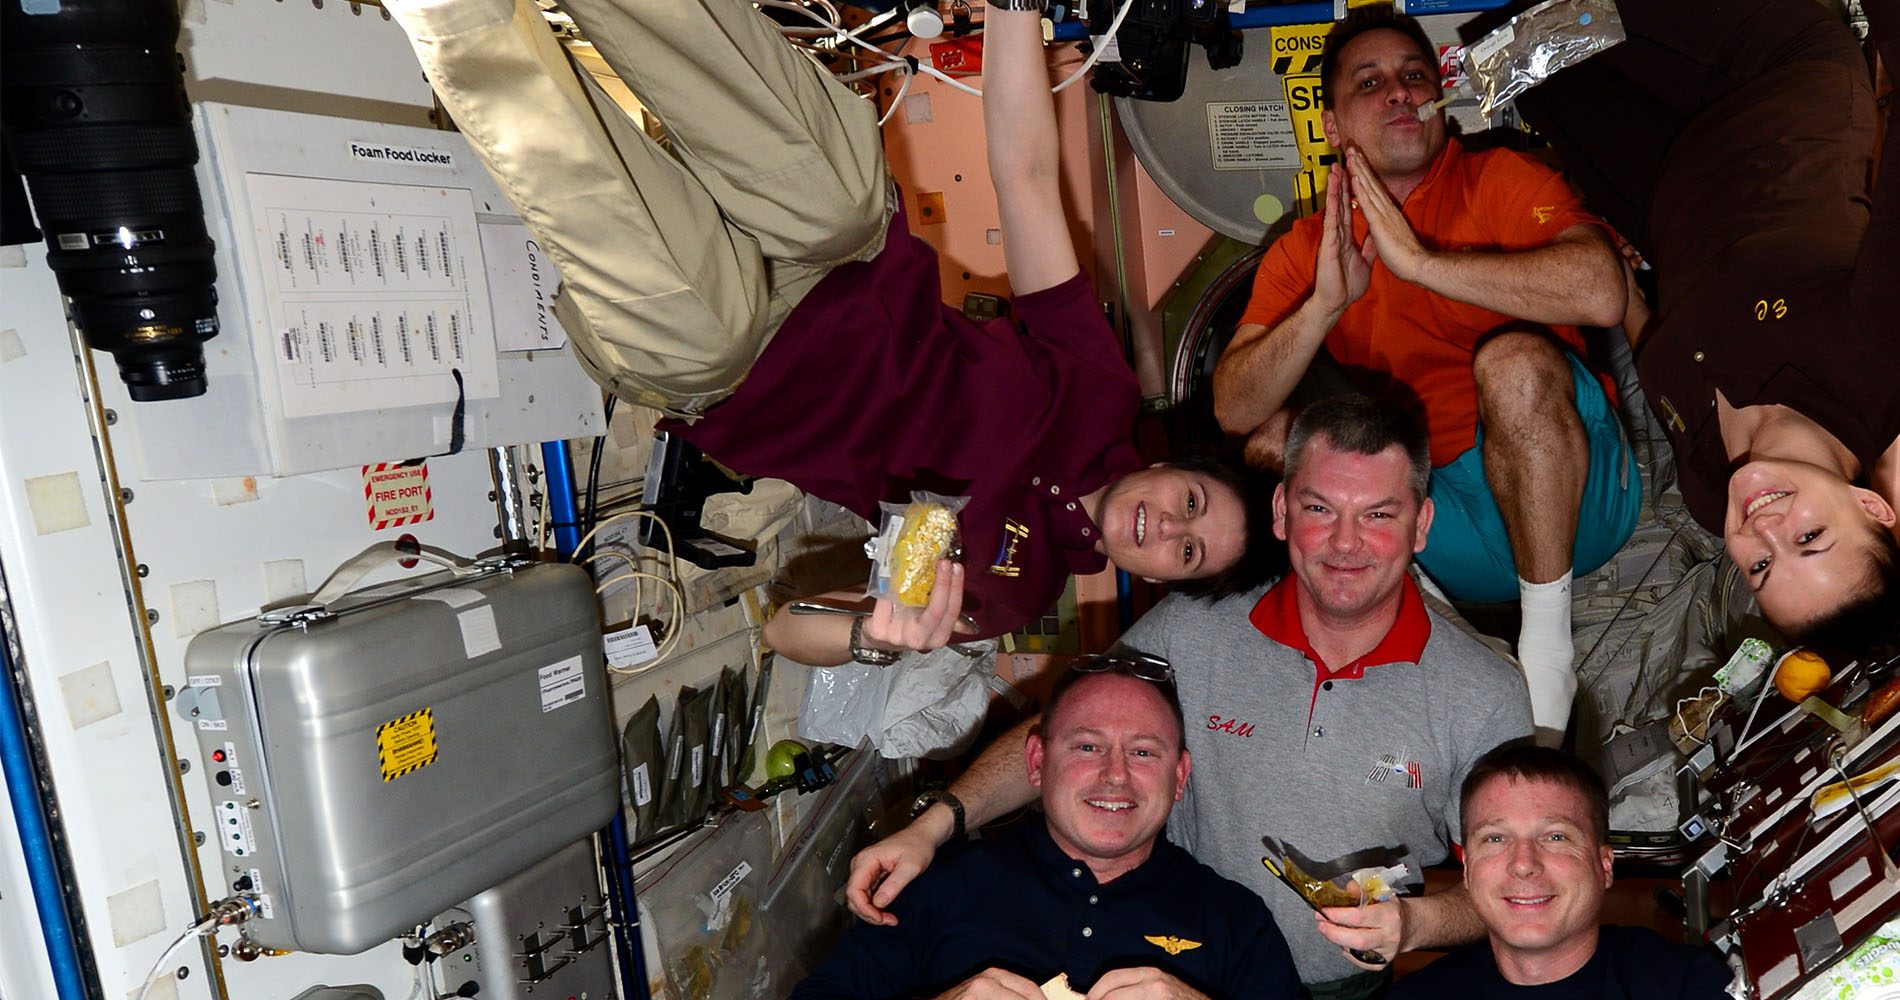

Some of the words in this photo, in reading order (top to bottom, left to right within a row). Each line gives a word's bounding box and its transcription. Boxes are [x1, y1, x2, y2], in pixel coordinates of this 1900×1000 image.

[1274, 35, 1326, 52] CONS
[352, 144, 384, 159] Foam
[384, 148, 413, 161] Food
[414, 150, 451, 164] Locker
[372, 472, 408, 482] EMERGENCY
[375, 490, 396, 502] FIRE
[398, 486, 422, 498] PORT
[1207, 715, 1255, 737] SAM
